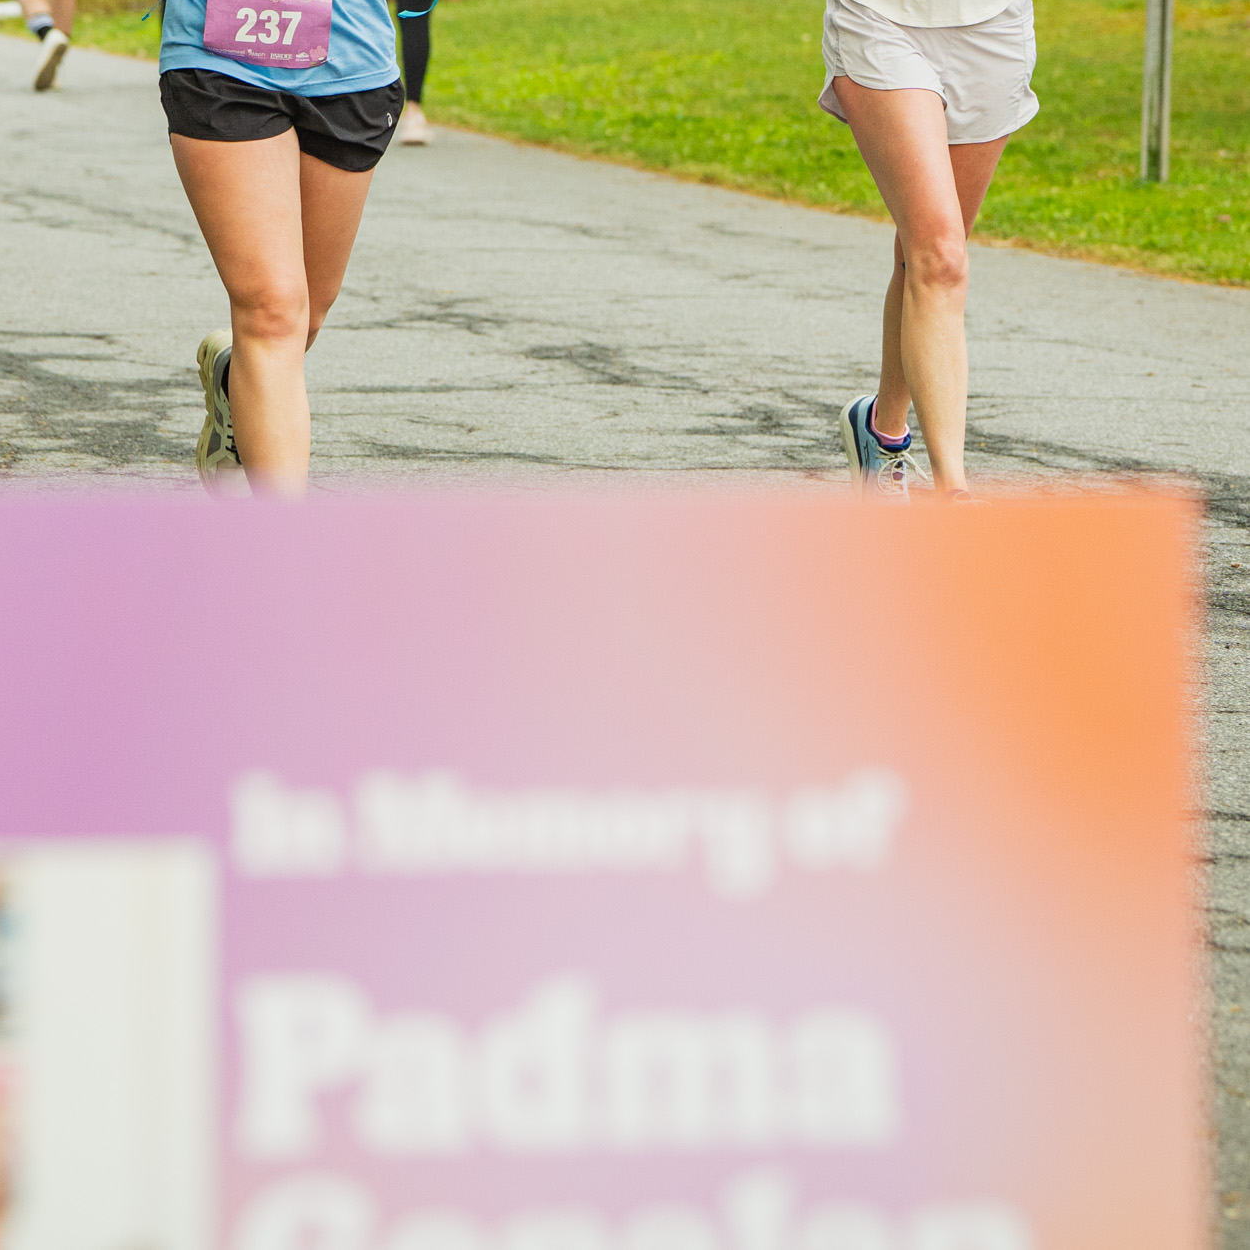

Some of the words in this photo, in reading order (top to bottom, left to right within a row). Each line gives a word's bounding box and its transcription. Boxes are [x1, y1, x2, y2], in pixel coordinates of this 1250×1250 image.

[235, 8, 302, 45] 237
[233, 770, 347, 876] In
[354, 770, 774, 900] Memory
[782, 766, 908, 872] of
[238, 970, 900, 1158] Padma
